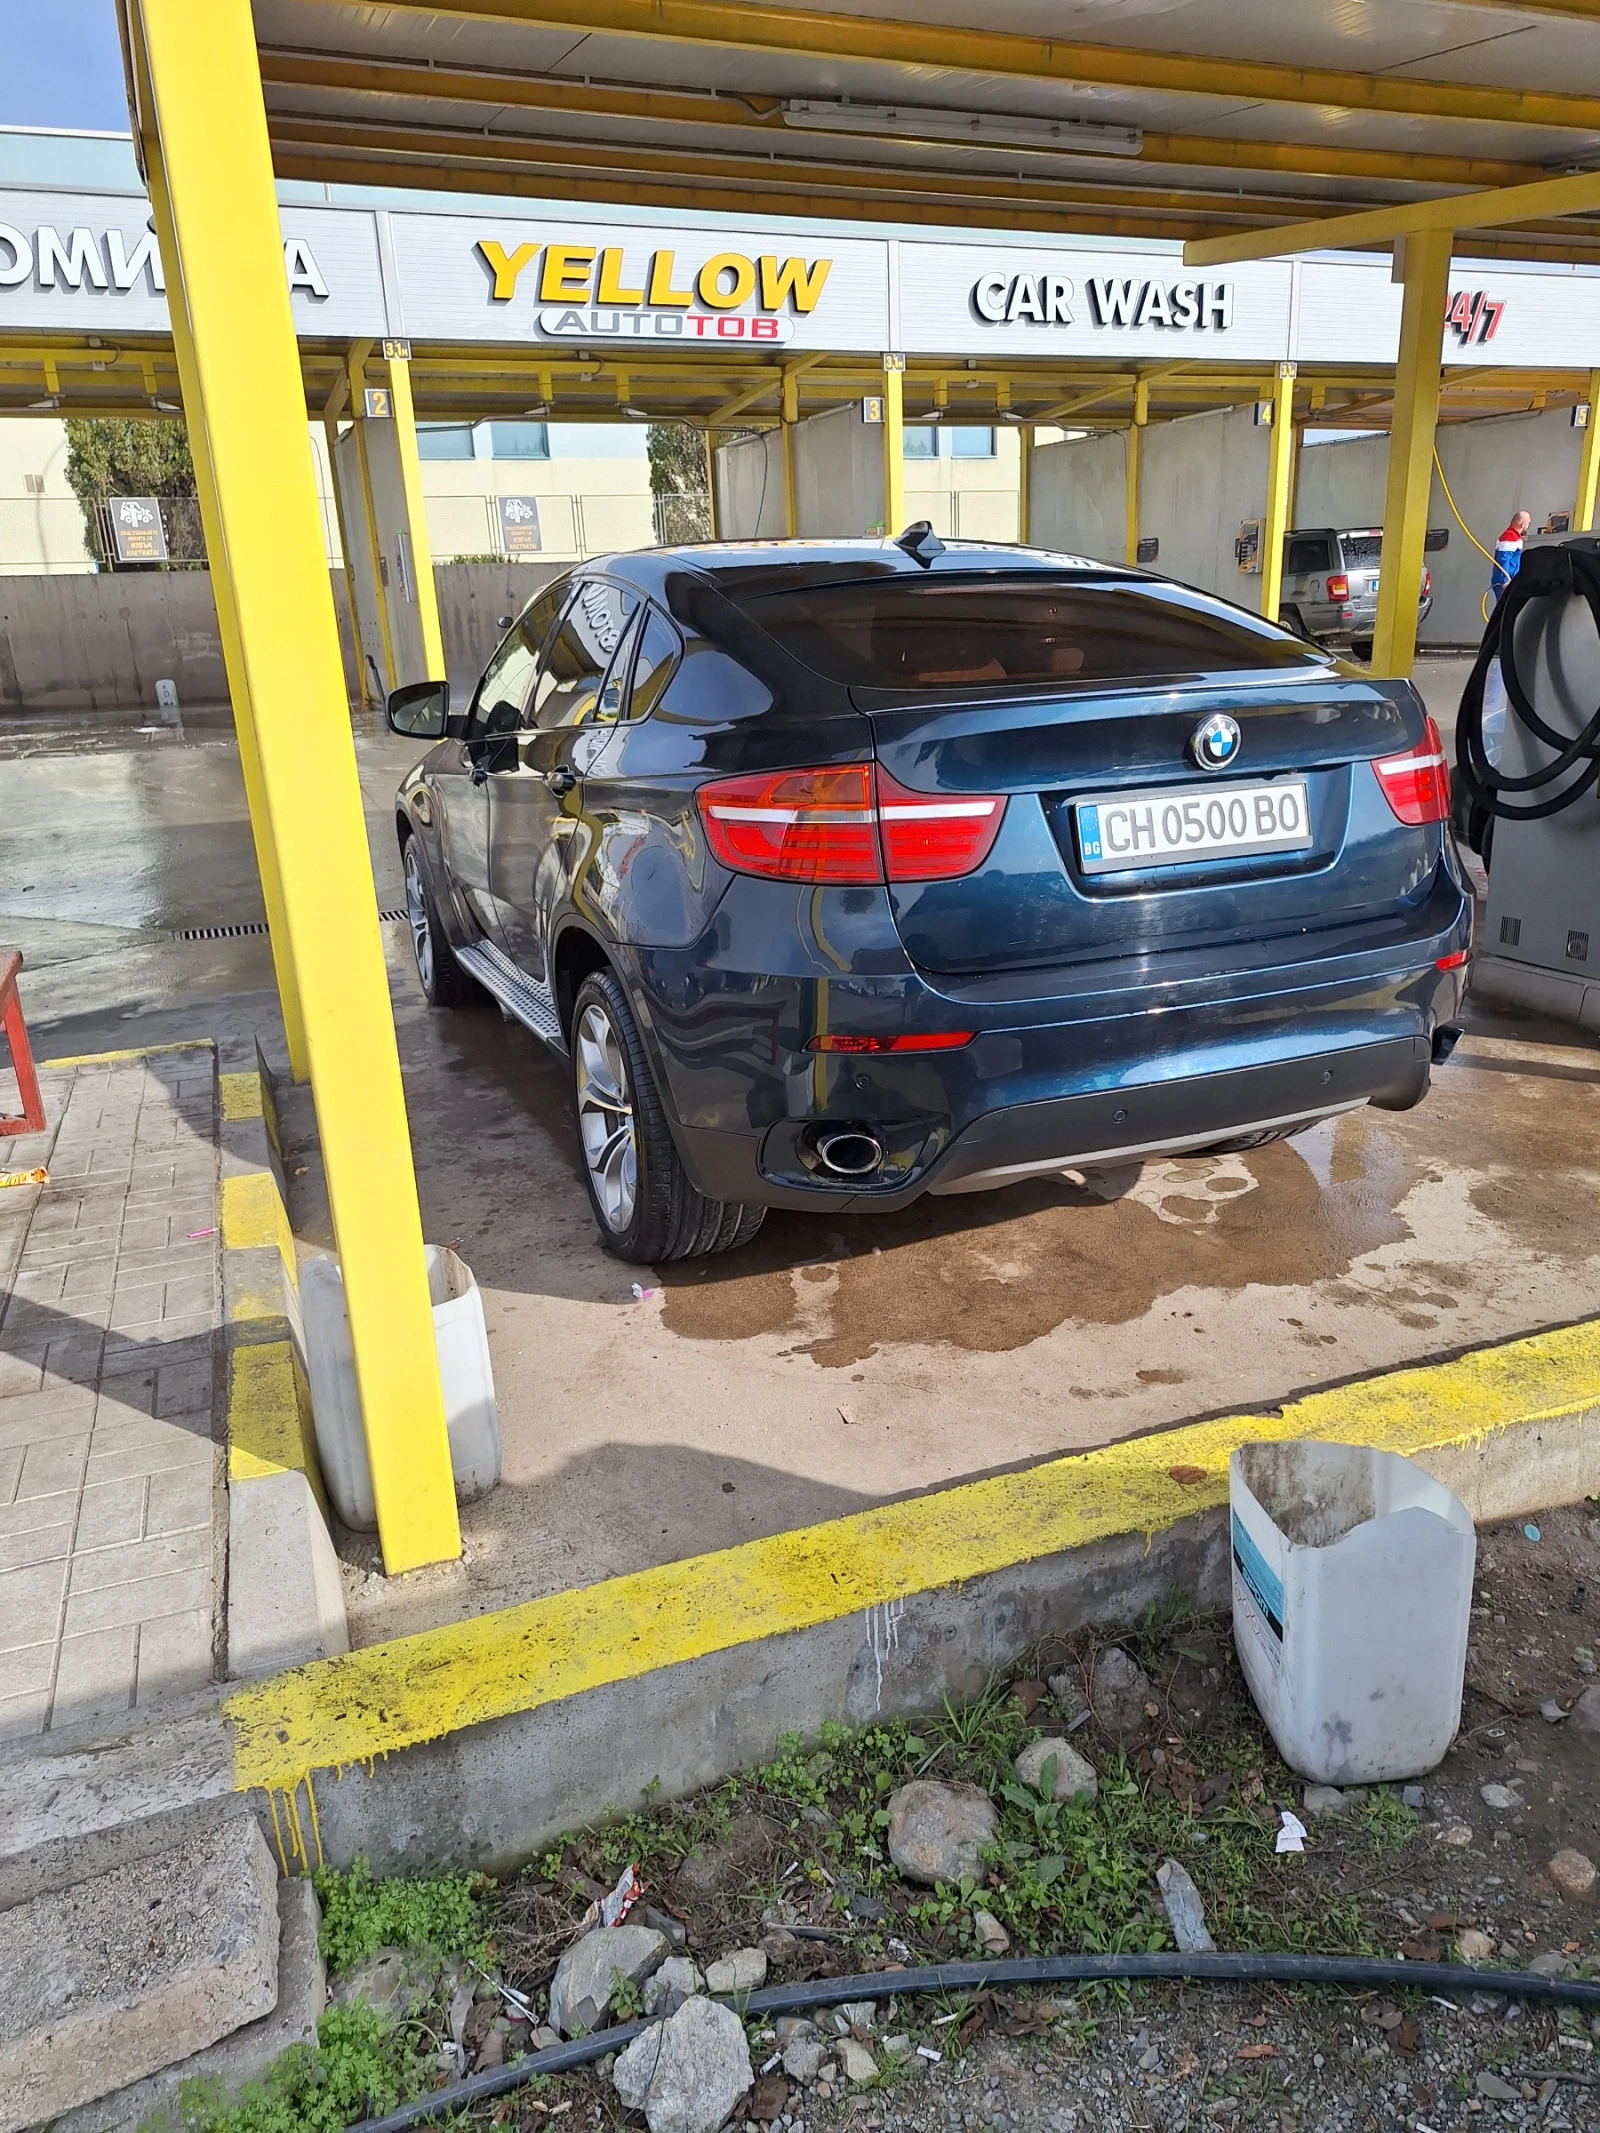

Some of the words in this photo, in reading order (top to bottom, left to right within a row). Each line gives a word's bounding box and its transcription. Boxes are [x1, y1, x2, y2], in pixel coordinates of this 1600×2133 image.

[476, 240, 833, 313] YELLOW
[972, 272, 1075, 324] CAR
[1087, 277, 1235, 329] WASH
[553, 310, 779, 339] AUTOTOB
[372, 392, 388, 415] 2
[869, 400, 880, 420] 3
[1262, 405, 1271, 424] 4
[1579, 408, 1588, 425] 5
[1206, 720, 1236, 736] BMW
[1105, 806, 1156, 851] CH
[1161, 798, 1247, 845] 0500
[1253, 793, 1300, 836] BO
[1084, 841, 1101, 856] BG
